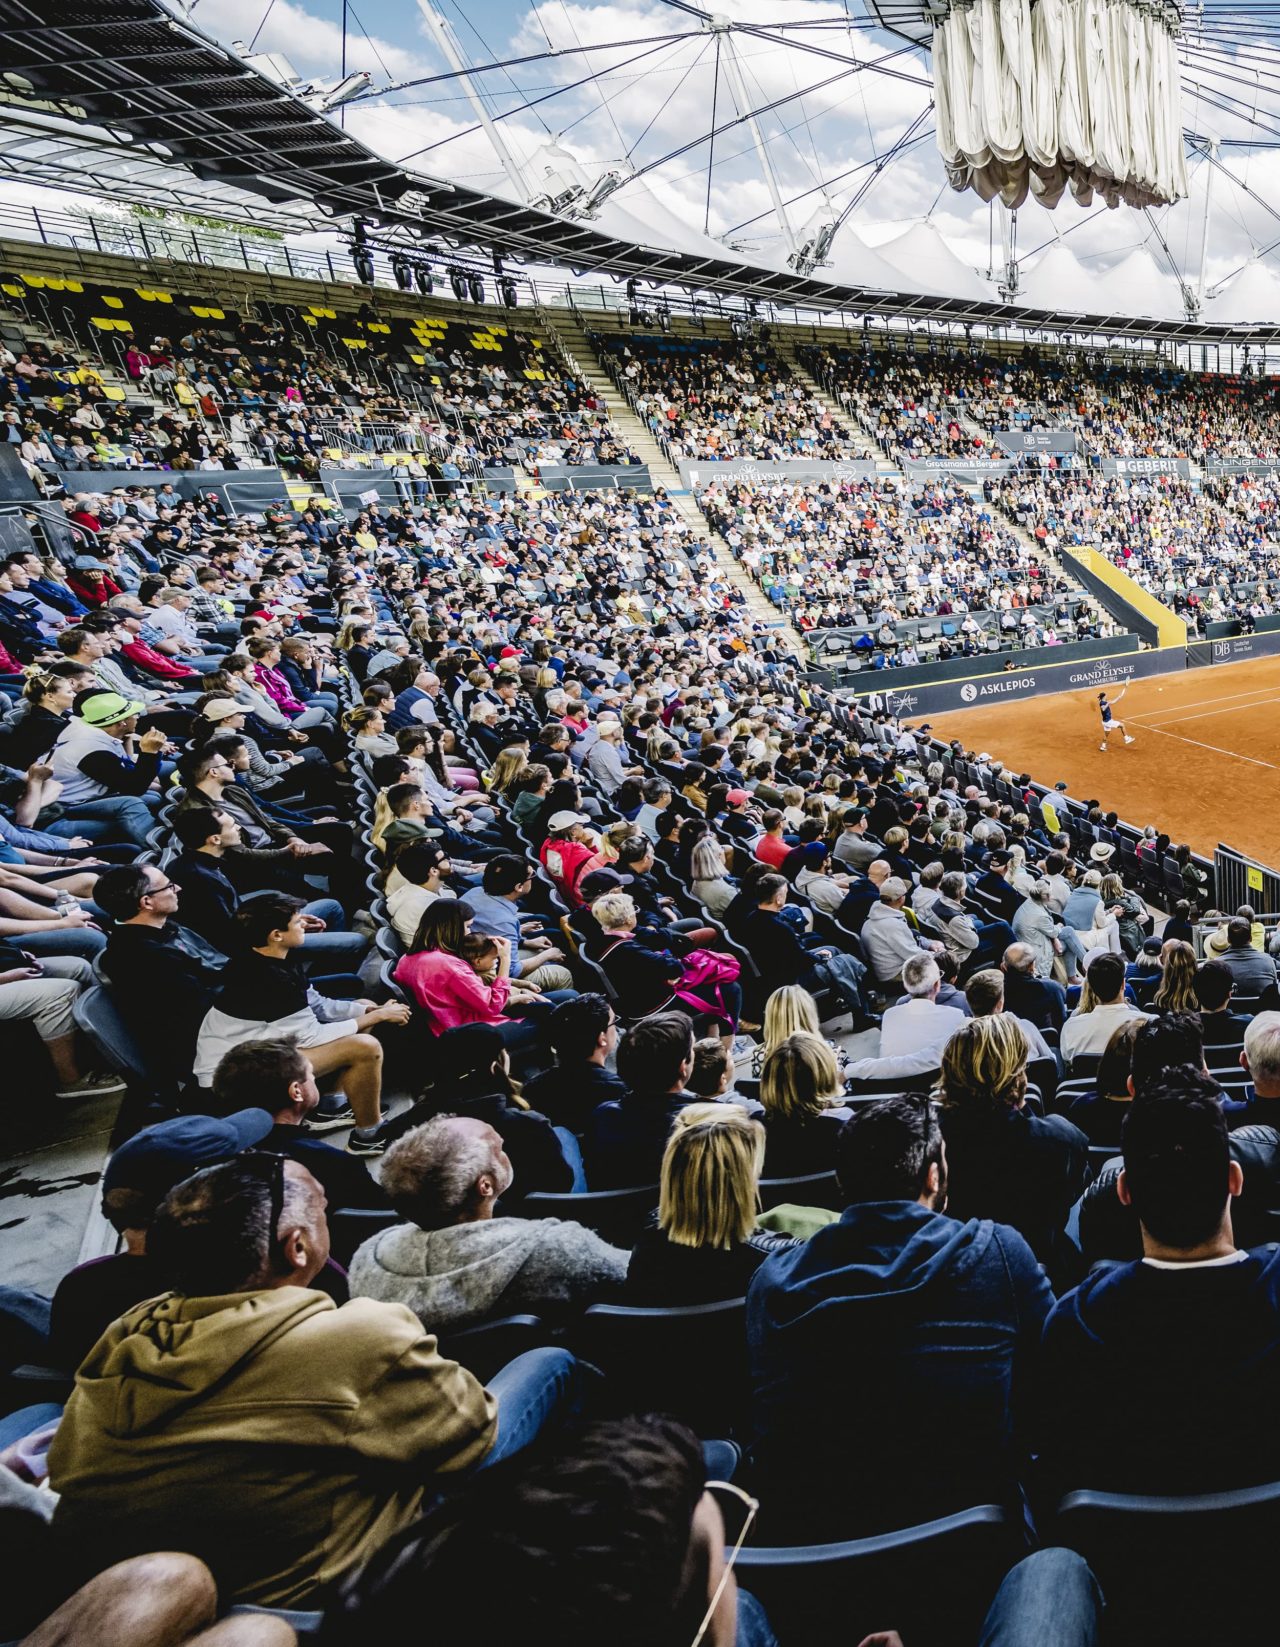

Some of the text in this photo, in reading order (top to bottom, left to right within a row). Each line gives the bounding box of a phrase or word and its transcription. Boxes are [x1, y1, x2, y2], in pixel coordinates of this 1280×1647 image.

[925, 459, 968, 468] Grossmann
[976, 460, 1000, 469] Berger
[1127, 460, 1178, 472] GEBERIT
[1069, 665, 1135, 683] GRAND ELYSEE
[979, 677, 1036, 696] ASKLEPIOS
